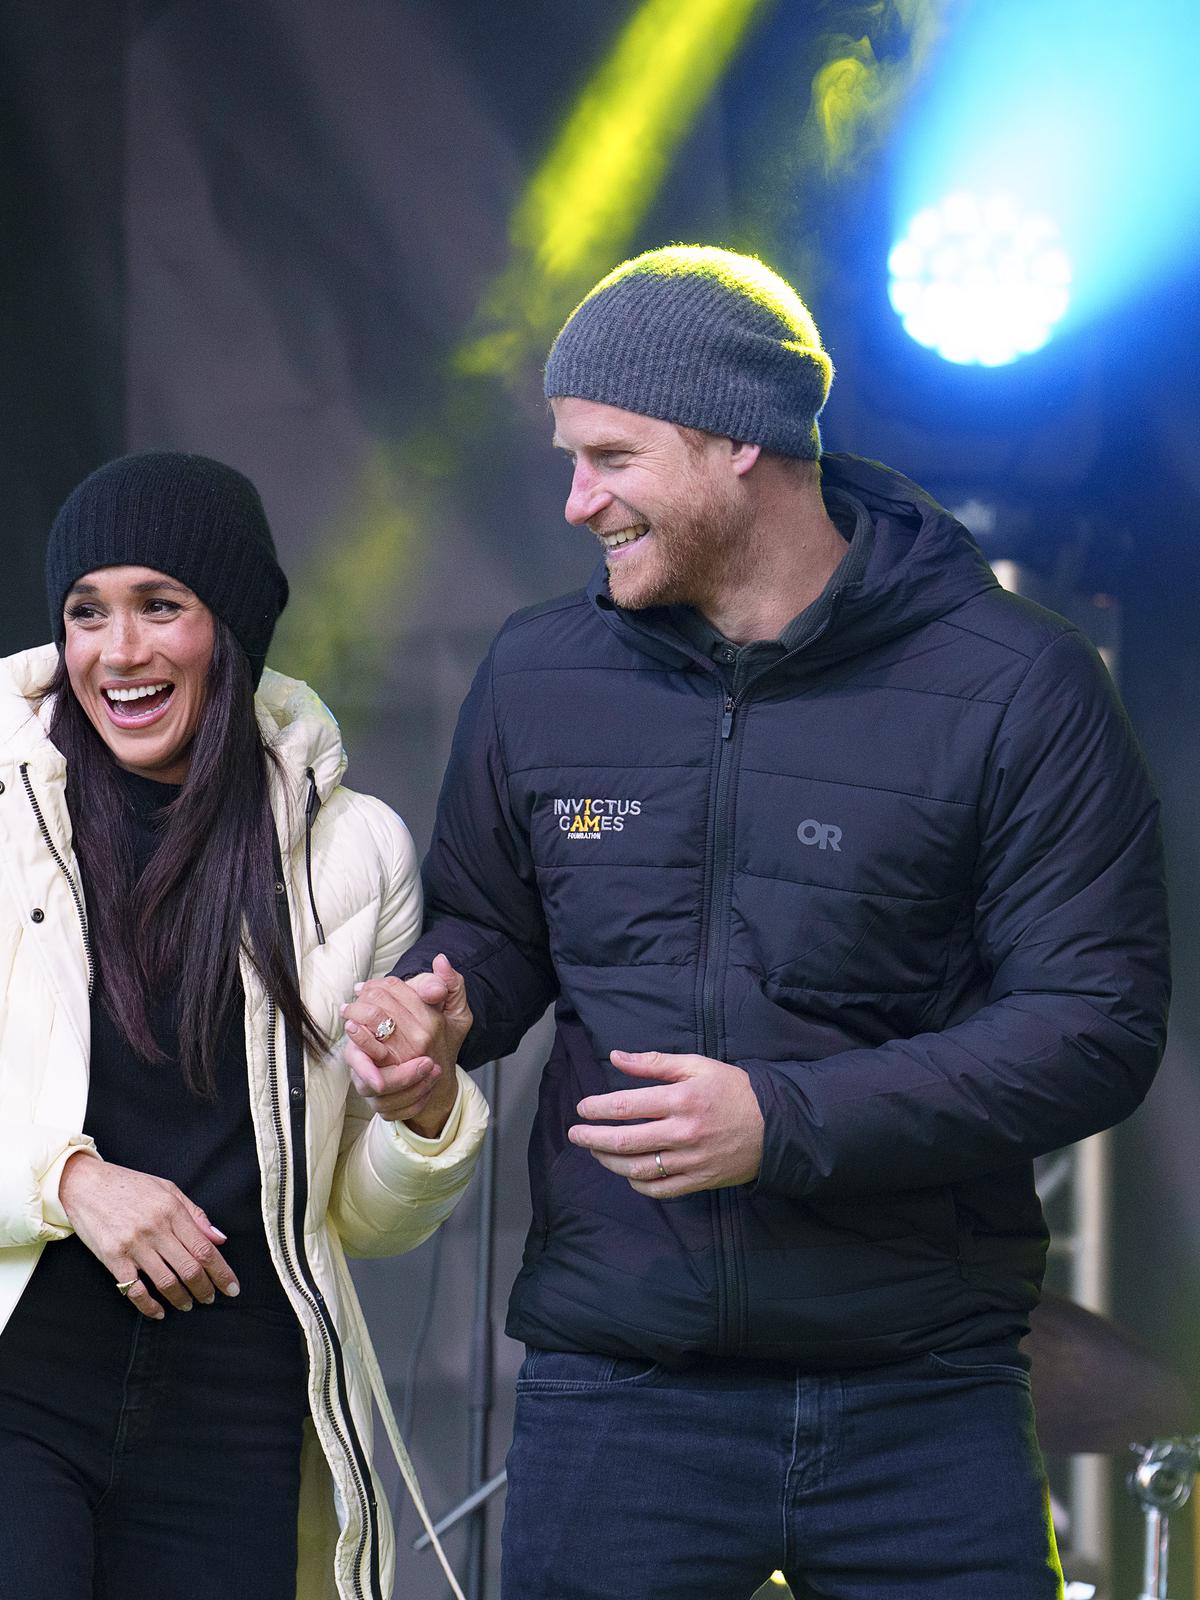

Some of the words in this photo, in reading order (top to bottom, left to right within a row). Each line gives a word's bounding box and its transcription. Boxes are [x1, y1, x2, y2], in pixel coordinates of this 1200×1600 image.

[553, 798, 641, 816] INVICTUS
[559, 815, 625, 832] GAMES
[796, 818, 843, 852] OR
